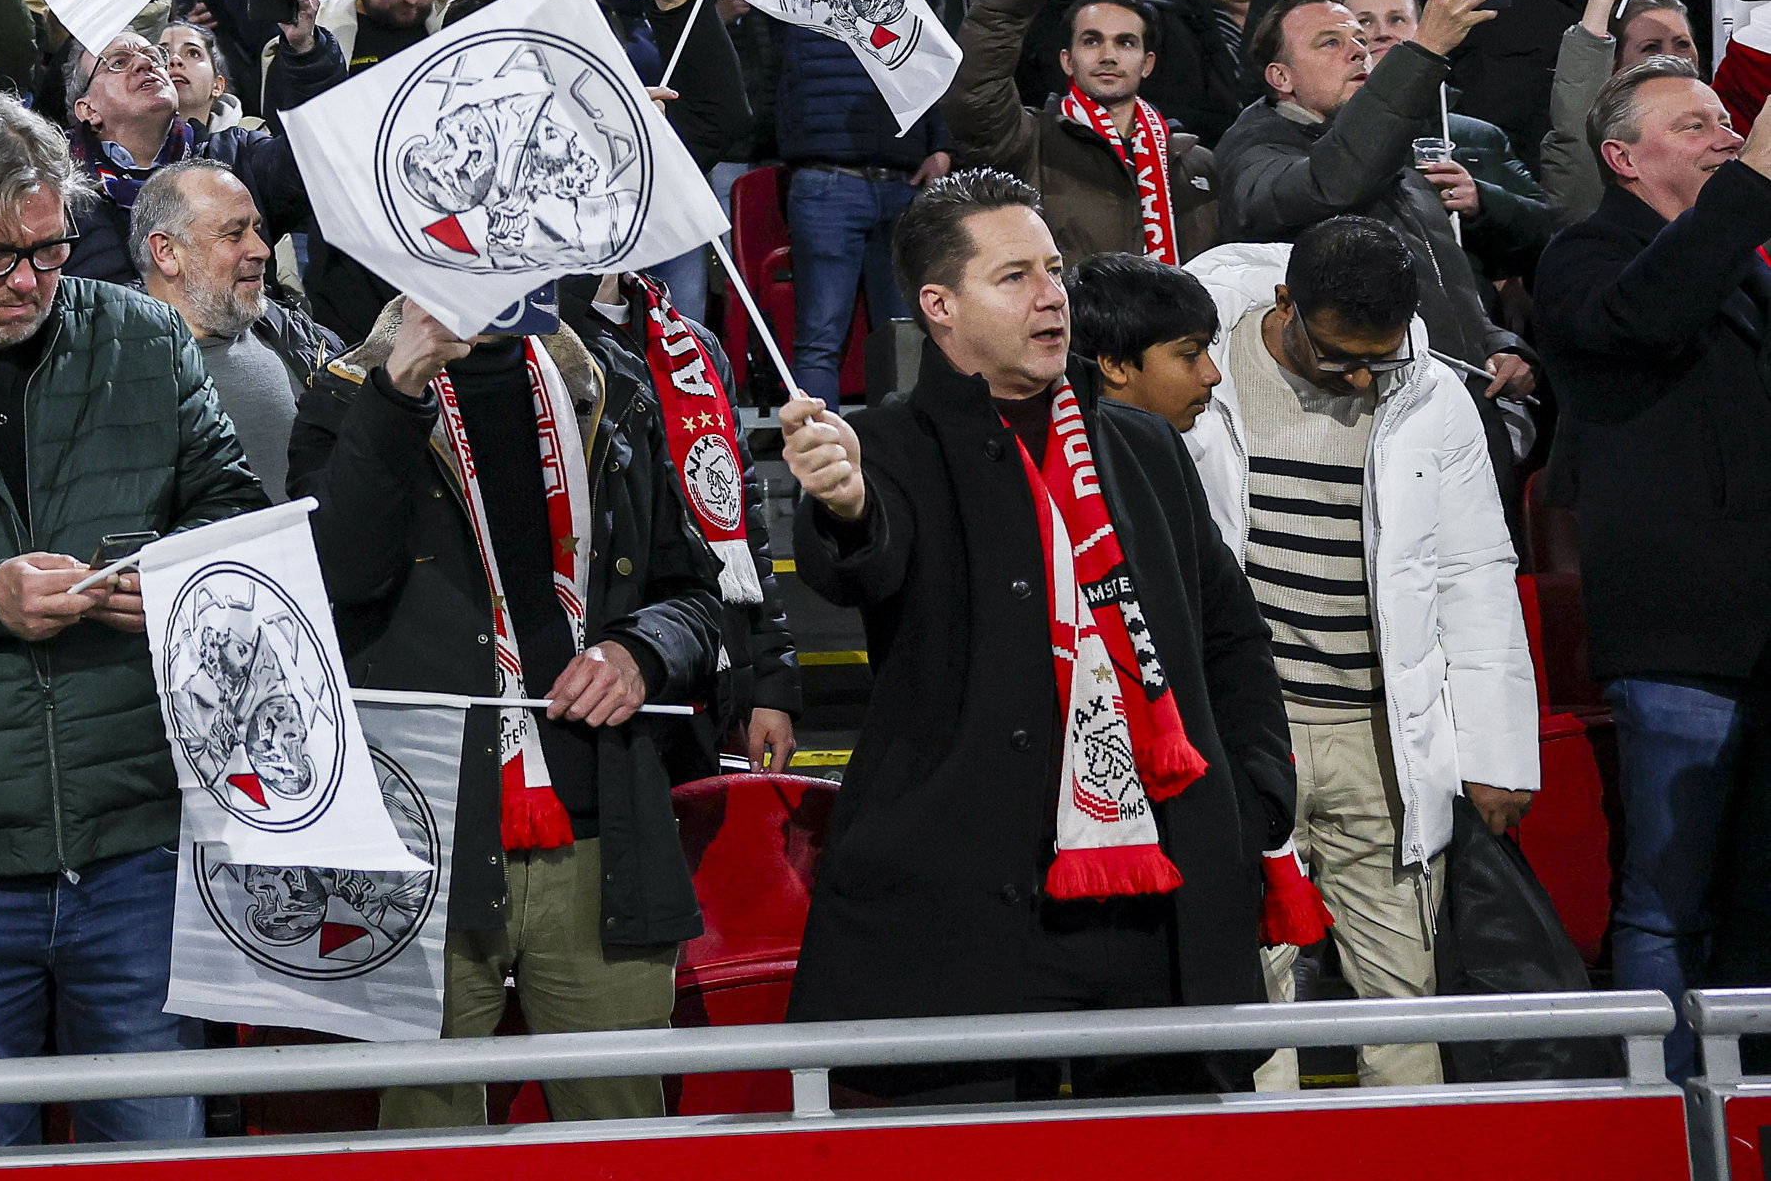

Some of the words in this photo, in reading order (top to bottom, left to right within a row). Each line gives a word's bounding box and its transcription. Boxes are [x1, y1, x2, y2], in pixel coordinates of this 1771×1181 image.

[688, 435, 714, 481] AJAX
[1086, 576, 1133, 603] MSTE
[194, 581, 334, 729] AJAX
